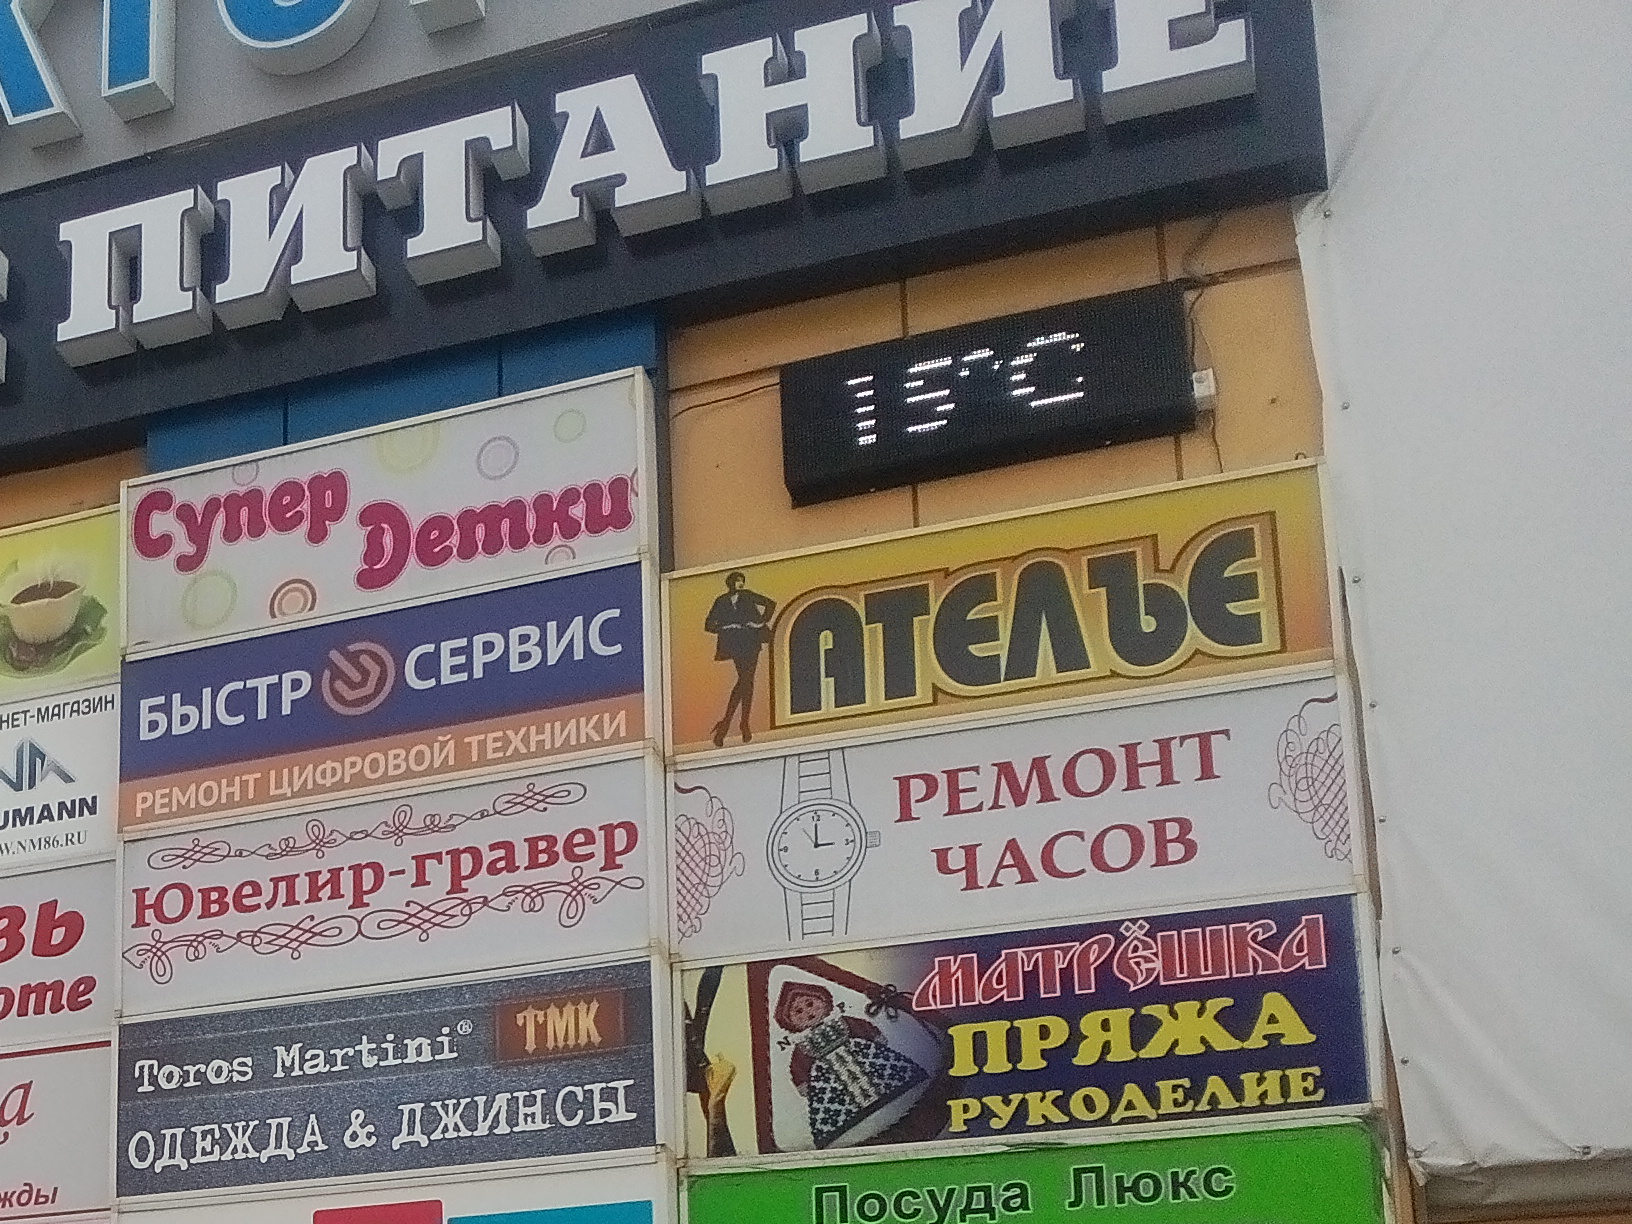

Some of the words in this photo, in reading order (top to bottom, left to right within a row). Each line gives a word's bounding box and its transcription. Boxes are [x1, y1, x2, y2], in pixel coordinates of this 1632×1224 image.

[56, 0, 1252, 345] ПИТАНИЕ
[131, 468, 350, 573] Супер
[354, 474, 636, 591] Детки
[403, 607, 623, 690] СЕРВИС
[135, 772, 262, 818] РЕМОНТ
[268, 733, 457, 797] ЦИФРОВОЙ
[464, 710, 628, 763] ТЕХНИКИ
[892, 727, 1231, 825] РЕМОНТ
[130, 819, 639, 929] Ювелир-гравер
[931, 816, 1199, 893] ЧАСОВ
[911, 912, 1329, 1012] МАТРЁШКА
[135, 1057, 254, 1093] Toros
[947, 989, 1317, 1078] ПРЯЖА
[127, 1112, 328, 1174] ОДЕЖДА
[343, 1109, 377, 1150] &
[391, 1078, 638, 1151] ДЖИНСЫ
[947, 1065, 1326, 1133] РУКОДЕЛИЕ
[1067, 1163, 1238, 1212] Люкс
